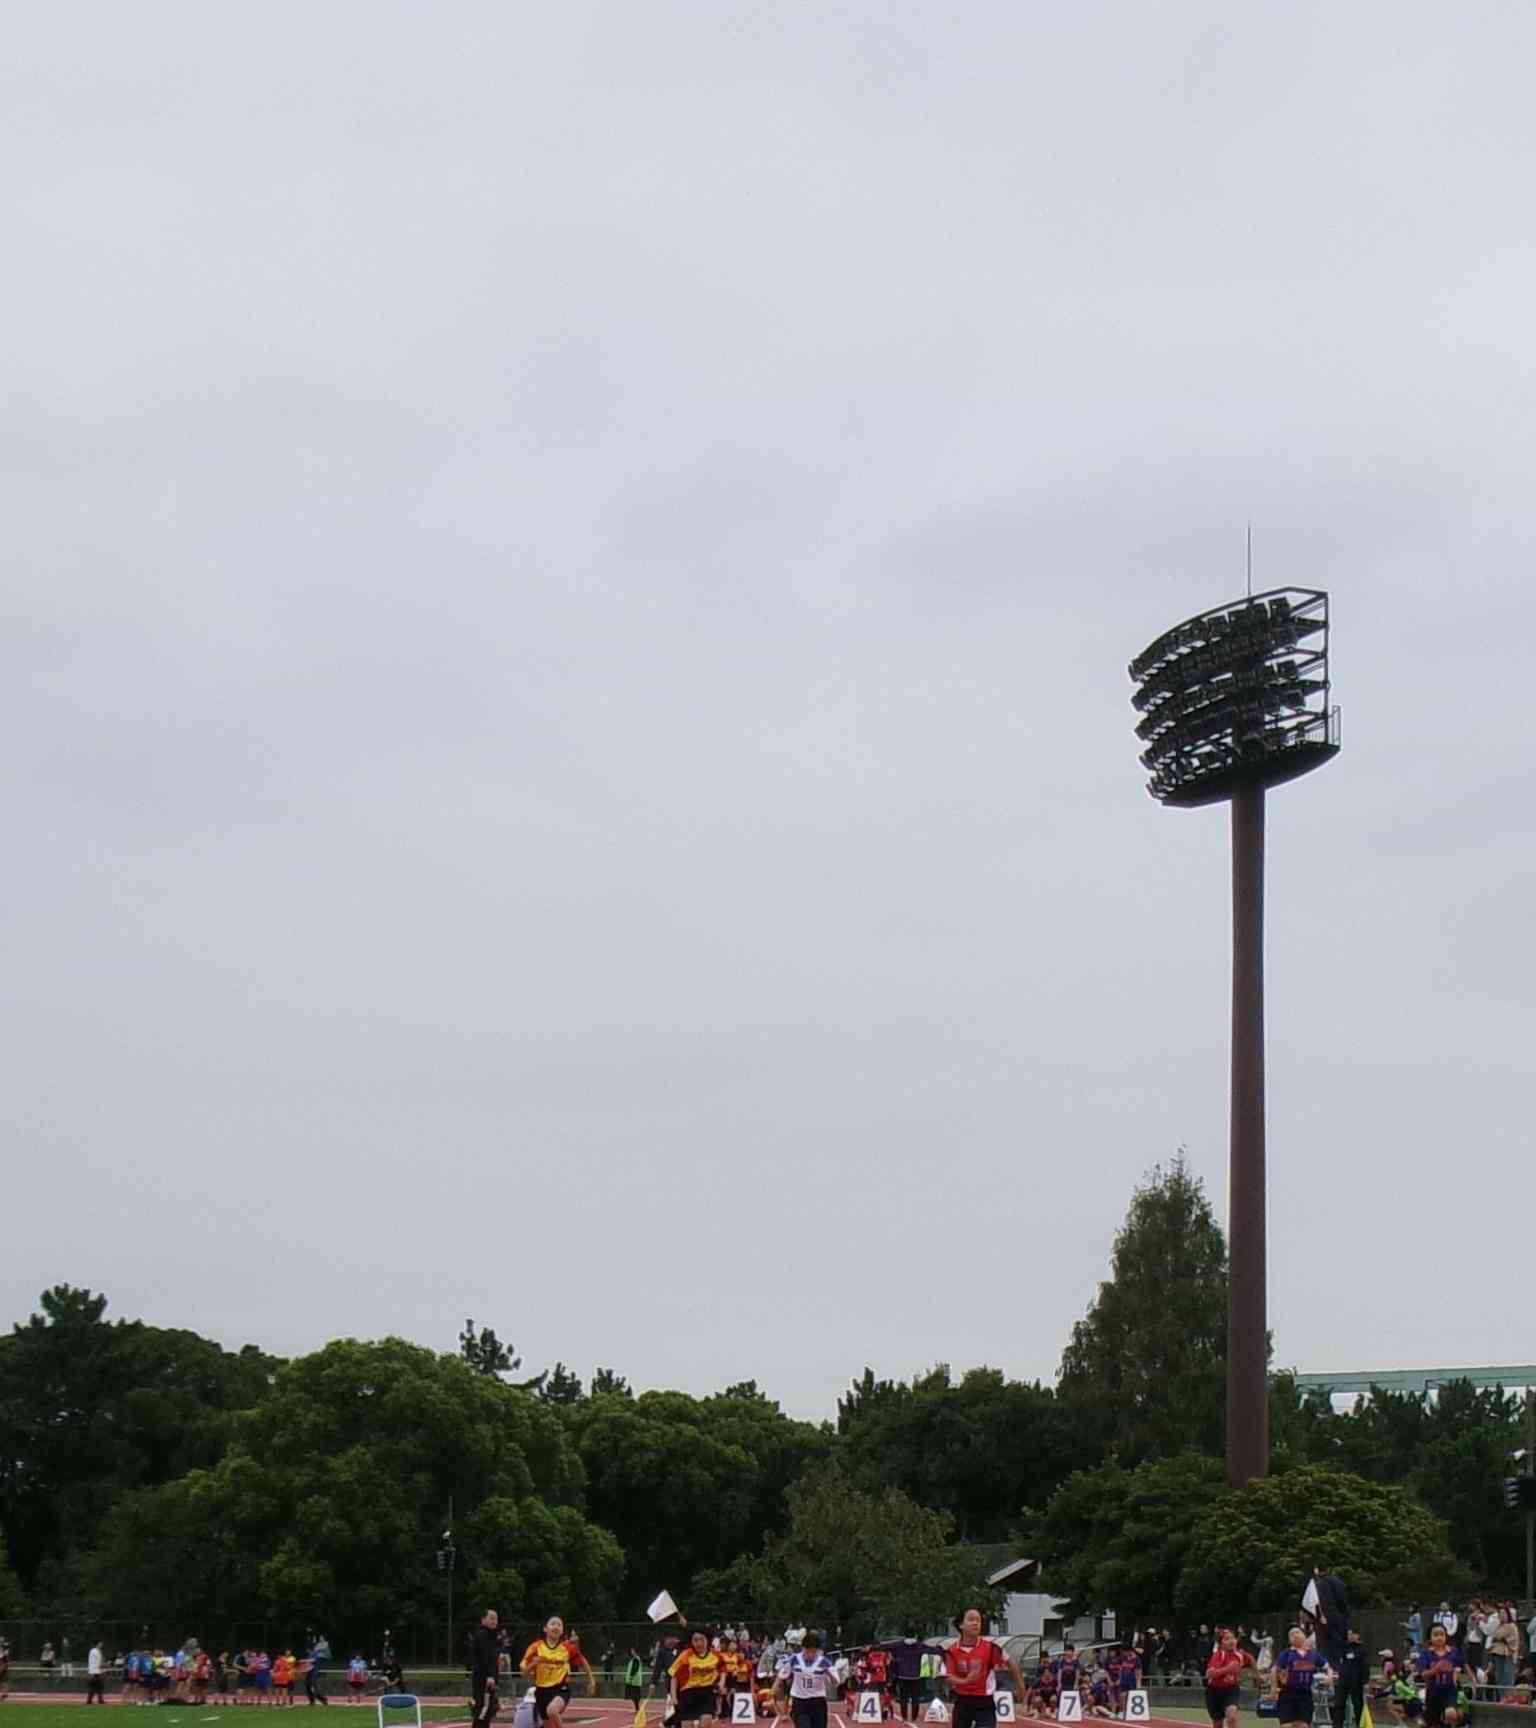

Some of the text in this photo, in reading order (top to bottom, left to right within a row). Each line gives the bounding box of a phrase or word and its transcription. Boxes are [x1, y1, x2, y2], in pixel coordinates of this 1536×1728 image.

[736, 1698, 752, 1719] 2
[864, 1697, 878, 1717] 4
[996, 1695, 1010, 1716] 6
[1064, 1695, 1078, 1715] 7
[1131, 1694, 1145, 1716] 8
